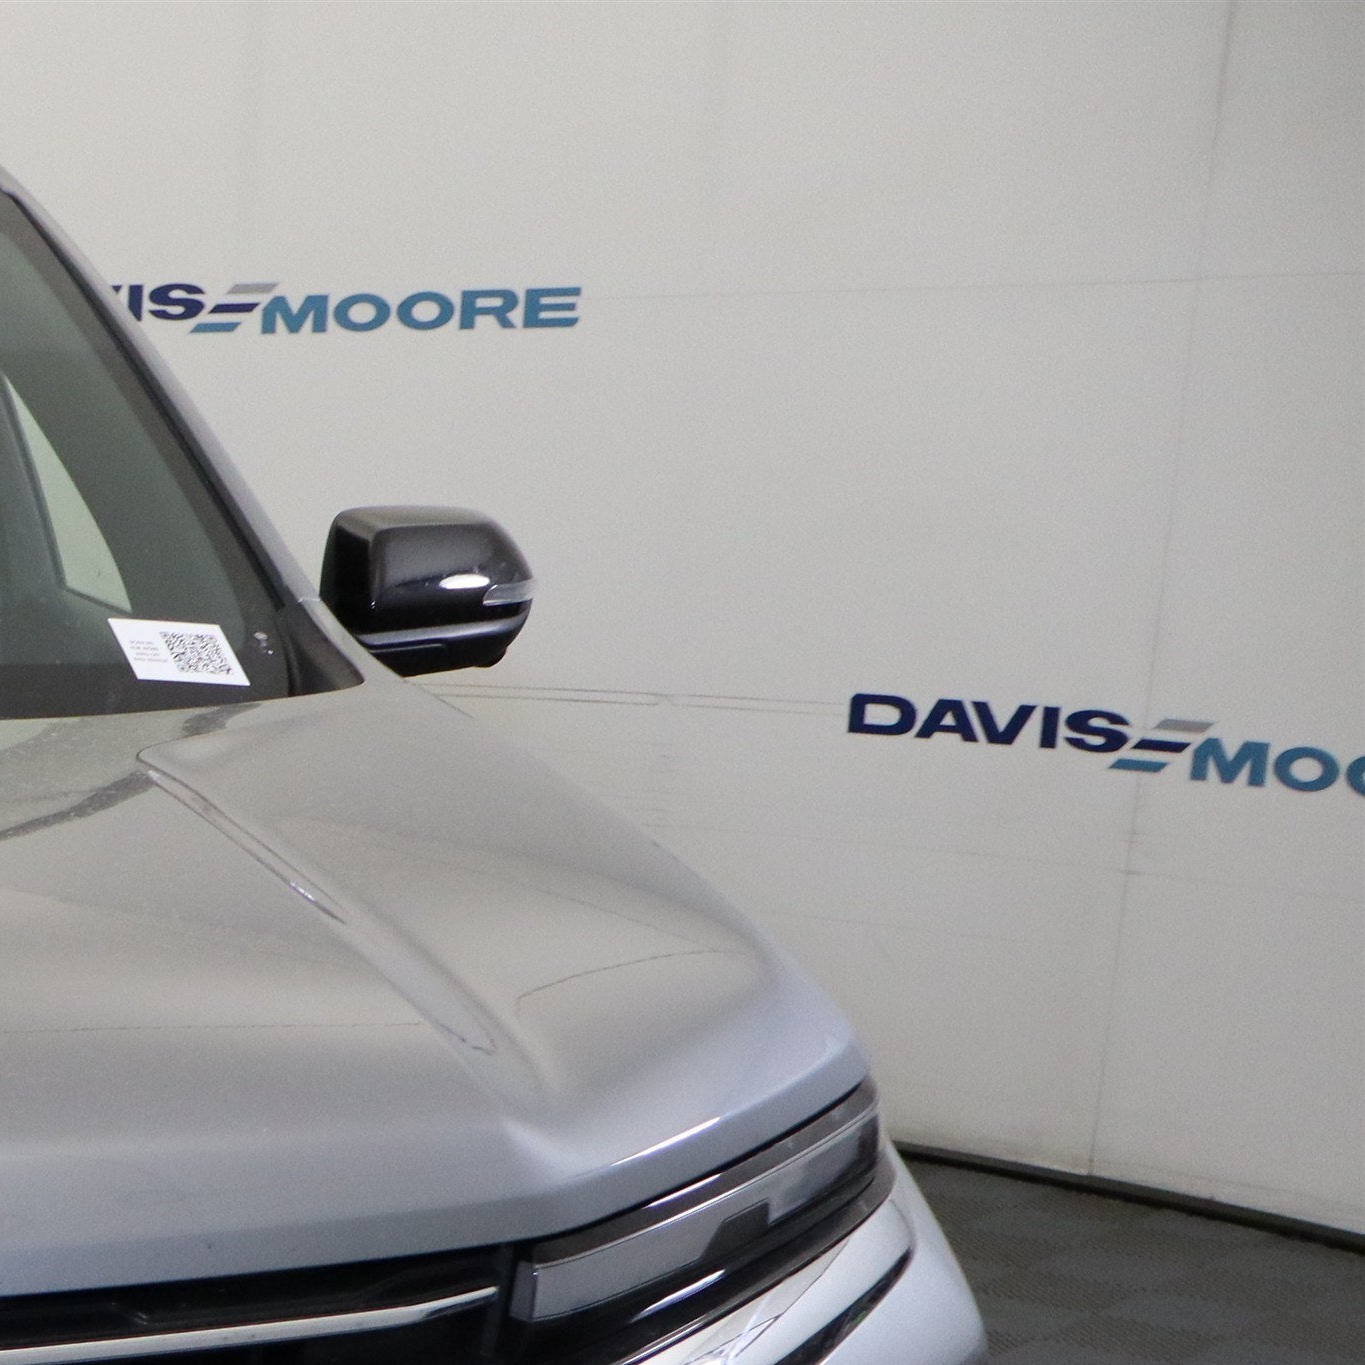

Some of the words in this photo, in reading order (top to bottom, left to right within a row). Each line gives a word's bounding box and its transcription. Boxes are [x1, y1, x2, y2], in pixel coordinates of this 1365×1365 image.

[261, 286, 582, 335] MOORE
[847, 692, 1131, 753] DAVIS
[1190, 736, 1365, 797] MO
